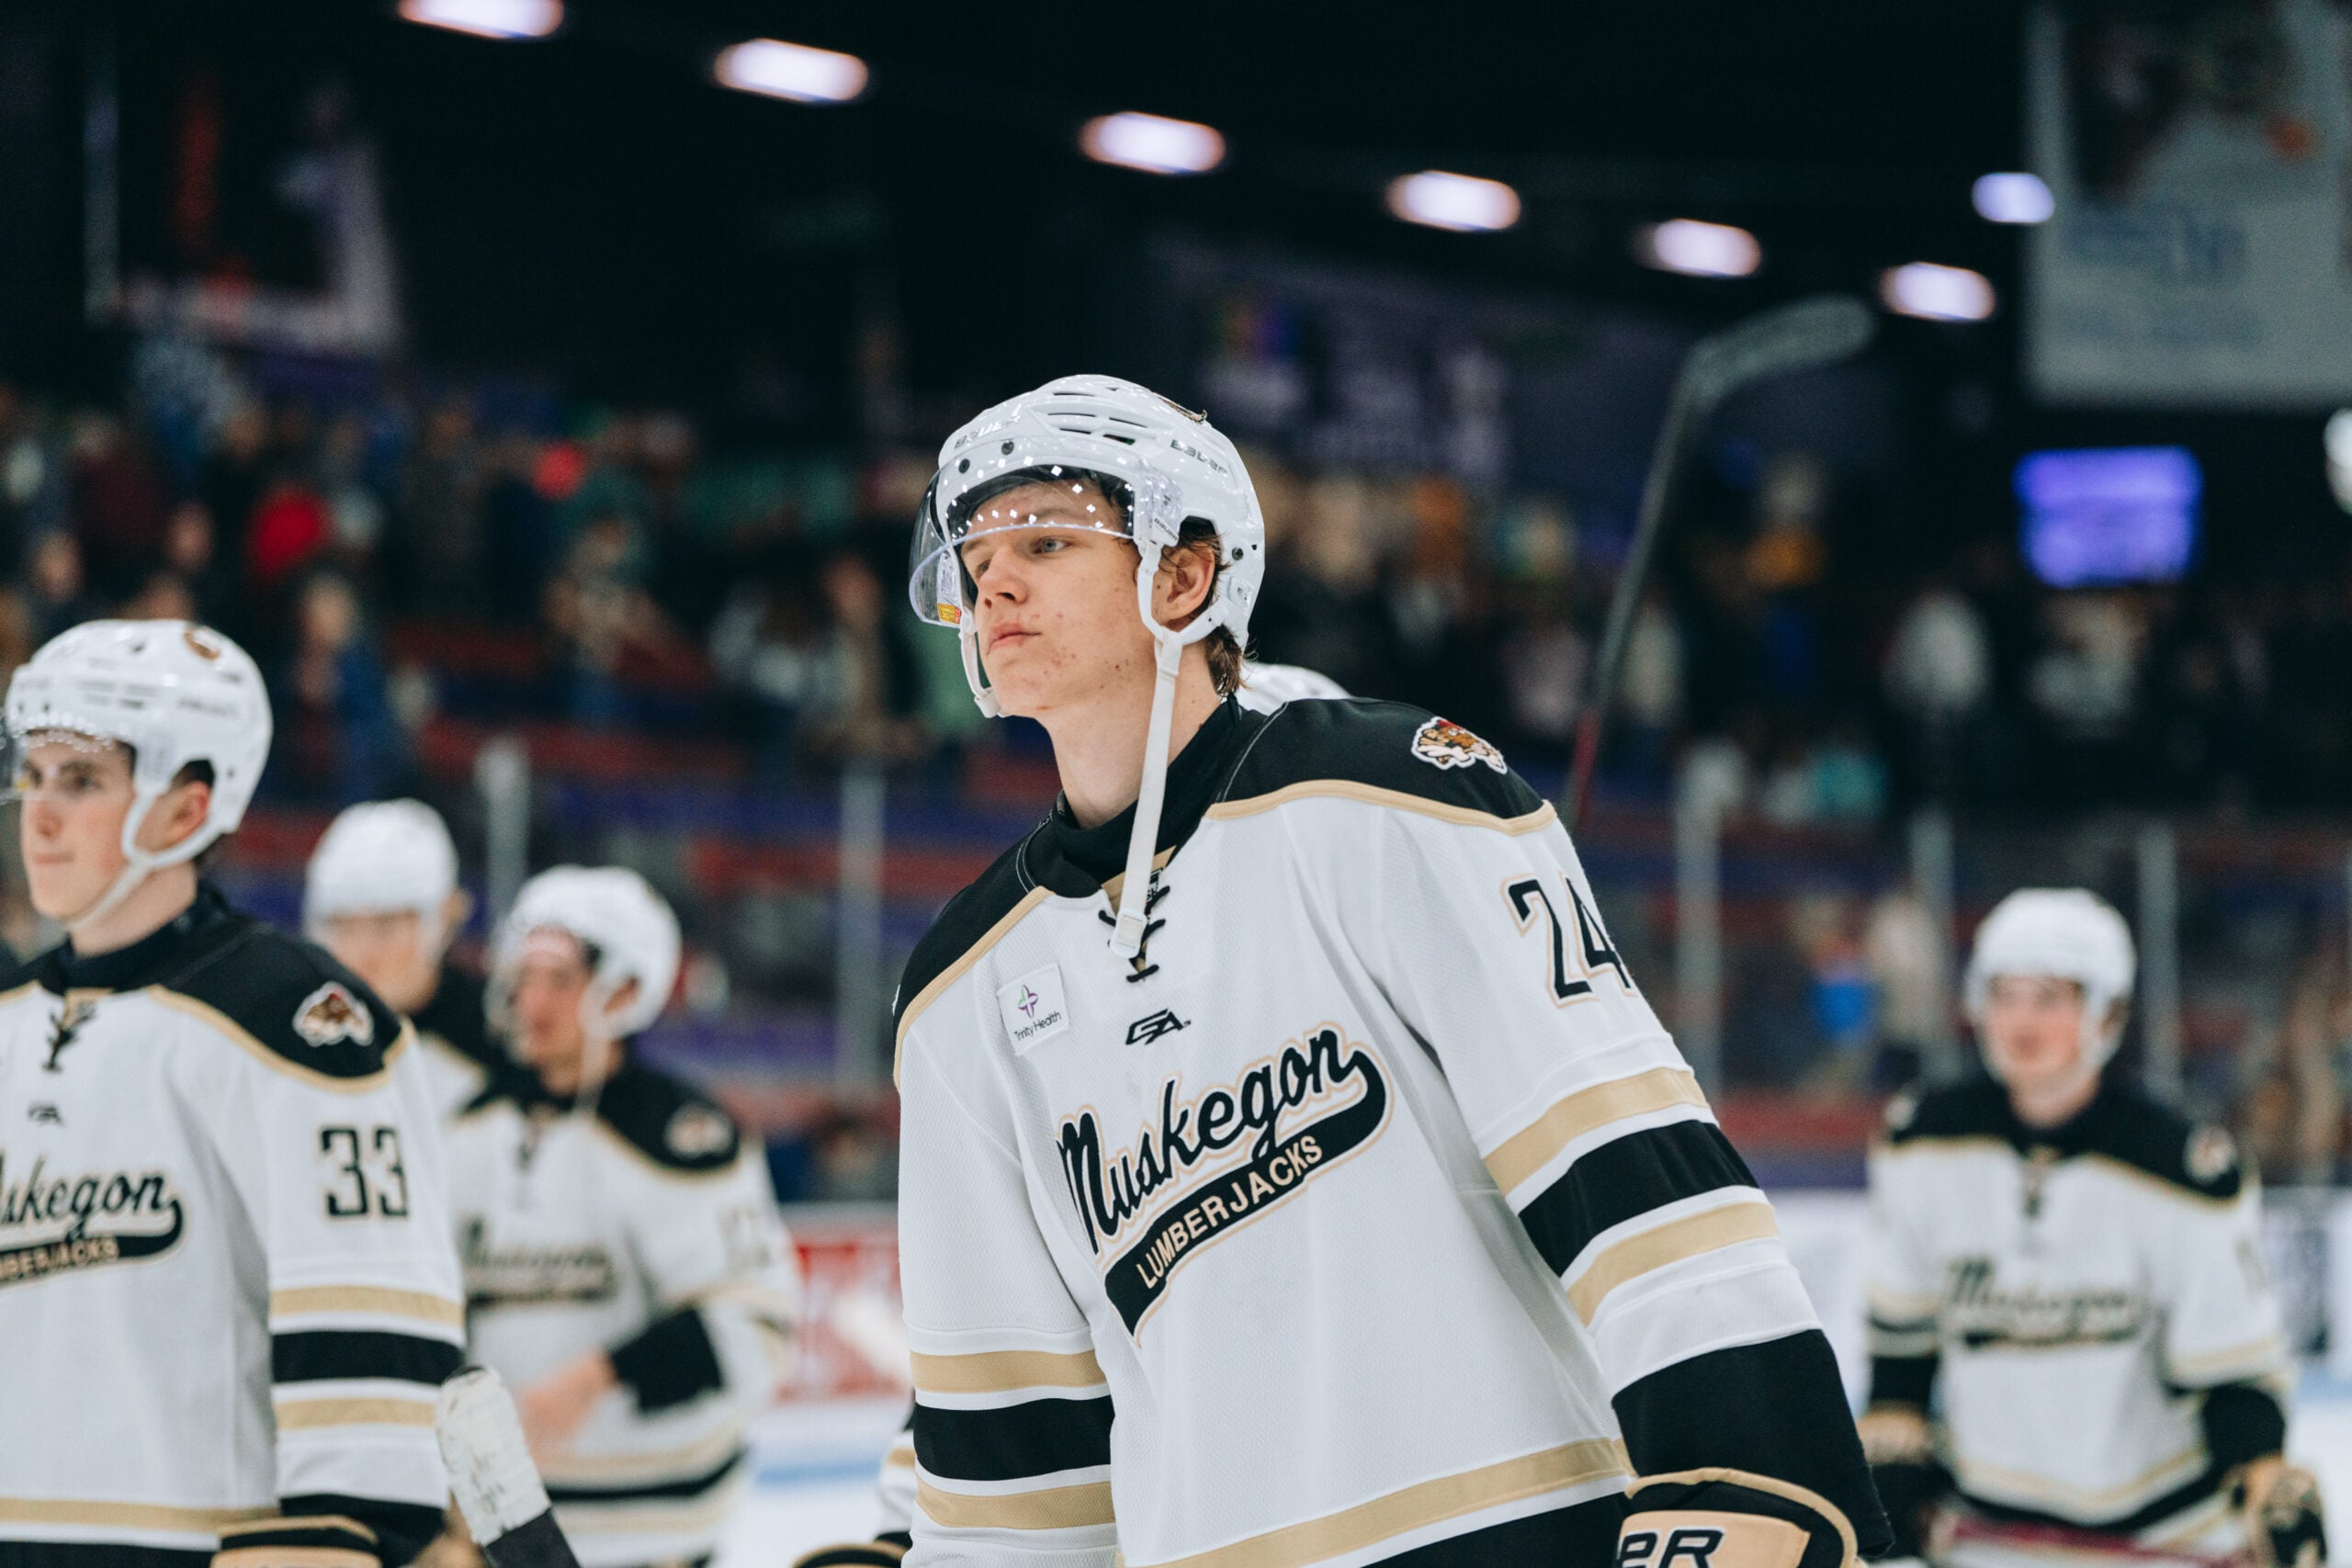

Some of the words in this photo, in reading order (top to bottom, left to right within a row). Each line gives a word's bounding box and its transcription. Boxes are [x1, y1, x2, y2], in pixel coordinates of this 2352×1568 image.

[1505, 874, 1634, 1002] 24
[1013, 1025, 1034, 1042] Trinity
[1033, 1010, 1062, 1032] Health
[320, 1125, 408, 1218] 33
[1057, 1029, 1352, 1255] Muskegon
[1136, 1134, 1323, 1289] LUMBERJACKS
